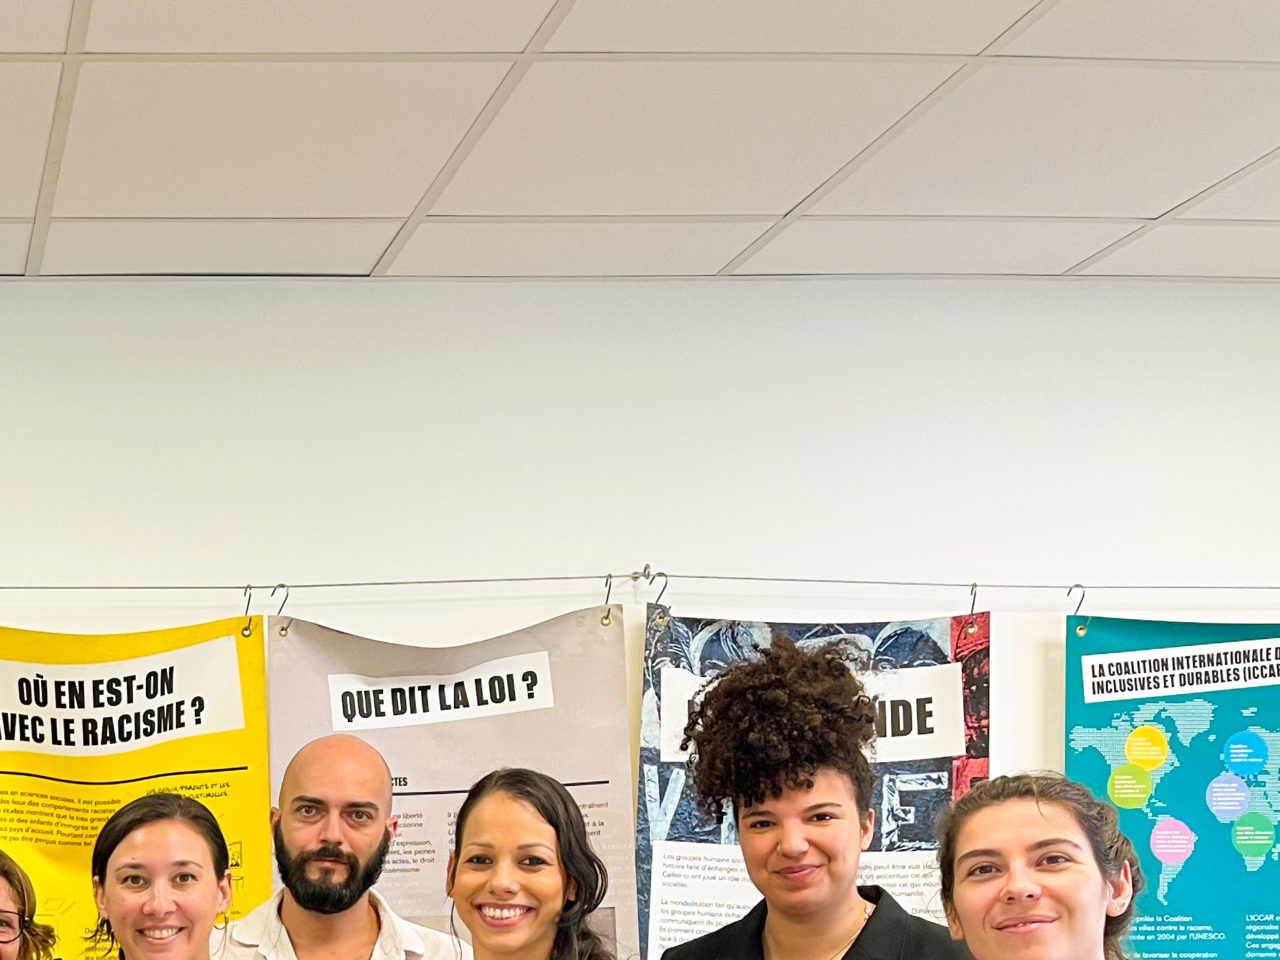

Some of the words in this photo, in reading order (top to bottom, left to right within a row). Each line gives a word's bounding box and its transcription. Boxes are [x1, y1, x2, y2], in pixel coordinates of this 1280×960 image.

[1091, 664, 1106, 678] LA
[1108, 658, 1169, 677] COALITION
[1171, 647, 1272, 671] INTERNATIONALE
[1092, 675, 1161, 695] INCLUSIVES
[1163, 674, 1175, 688] ET
[1179, 668, 1240, 687] DURABLES
[17, 673, 48, 708] OÙ
[54, 680, 85, 709] EN
[91, 666, 175, 709] EST-ON
[341, 689, 386, 723] QUE
[389, 685, 432, 716] DIT
[438, 681, 470, 711] LA
[474, 673, 517, 706] LOI
[521, 670, 538, 699] ?
[50, 716, 76, 747] LE
[81, 700, 185, 747] RACISME
[190, 695, 205, 725] ?
